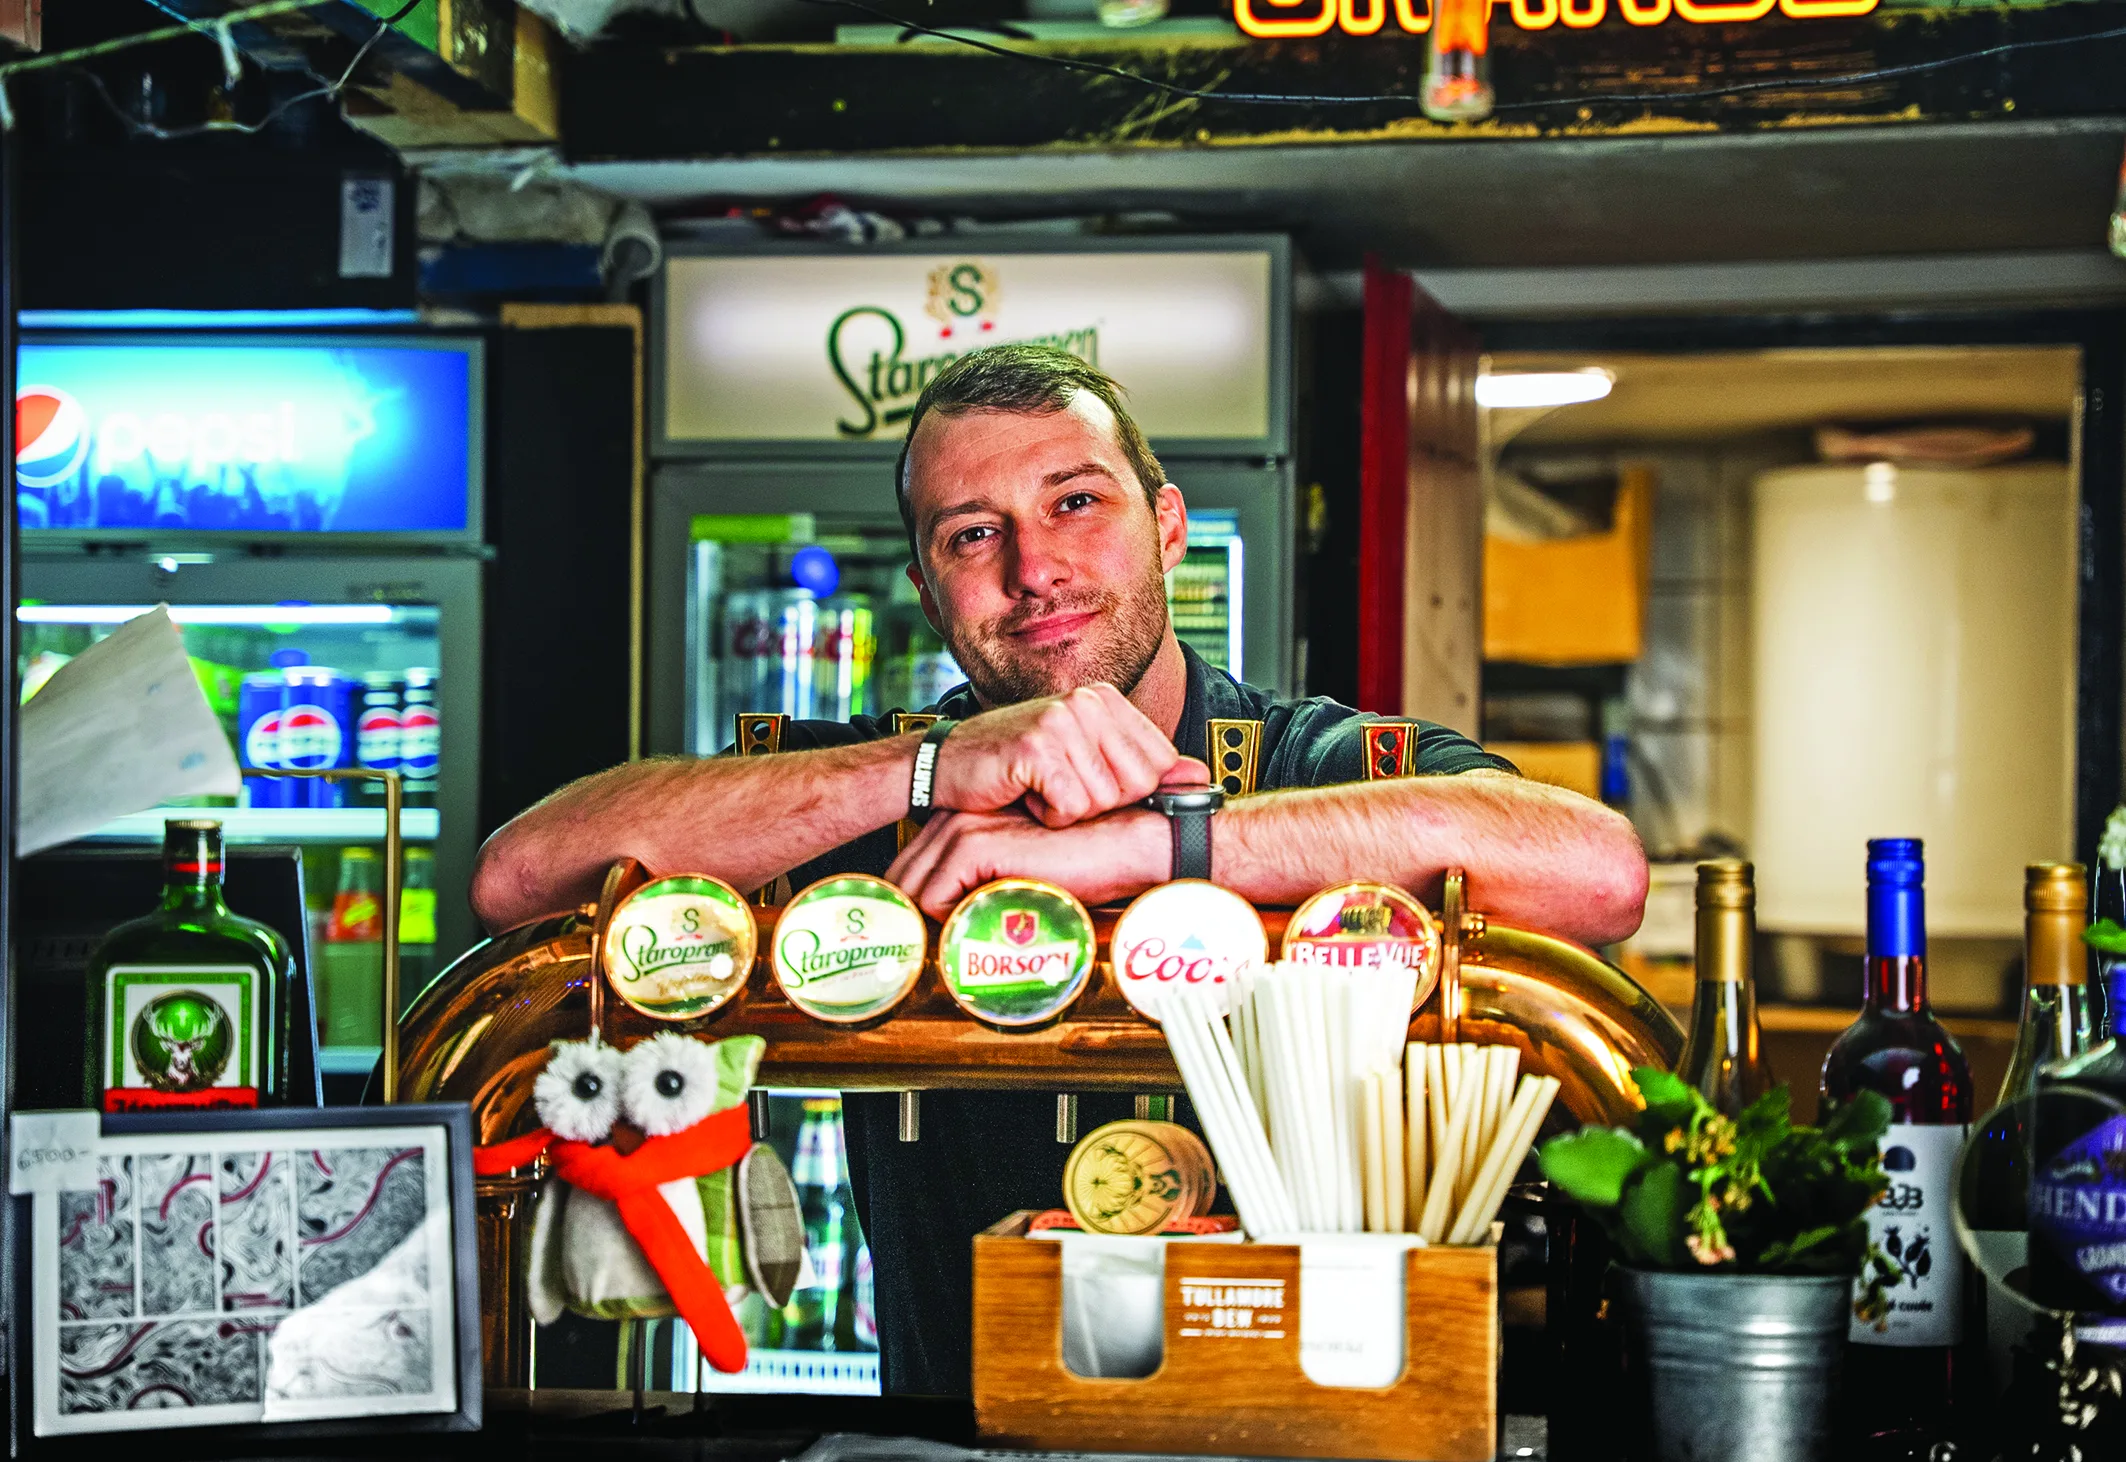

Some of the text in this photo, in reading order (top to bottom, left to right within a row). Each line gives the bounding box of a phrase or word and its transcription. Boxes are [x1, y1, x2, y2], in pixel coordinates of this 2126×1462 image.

[97, 401, 294, 476] pepsi
[911, 742, 938, 807] SPARTAN
[966, 951, 1070, 977] BORSOI
